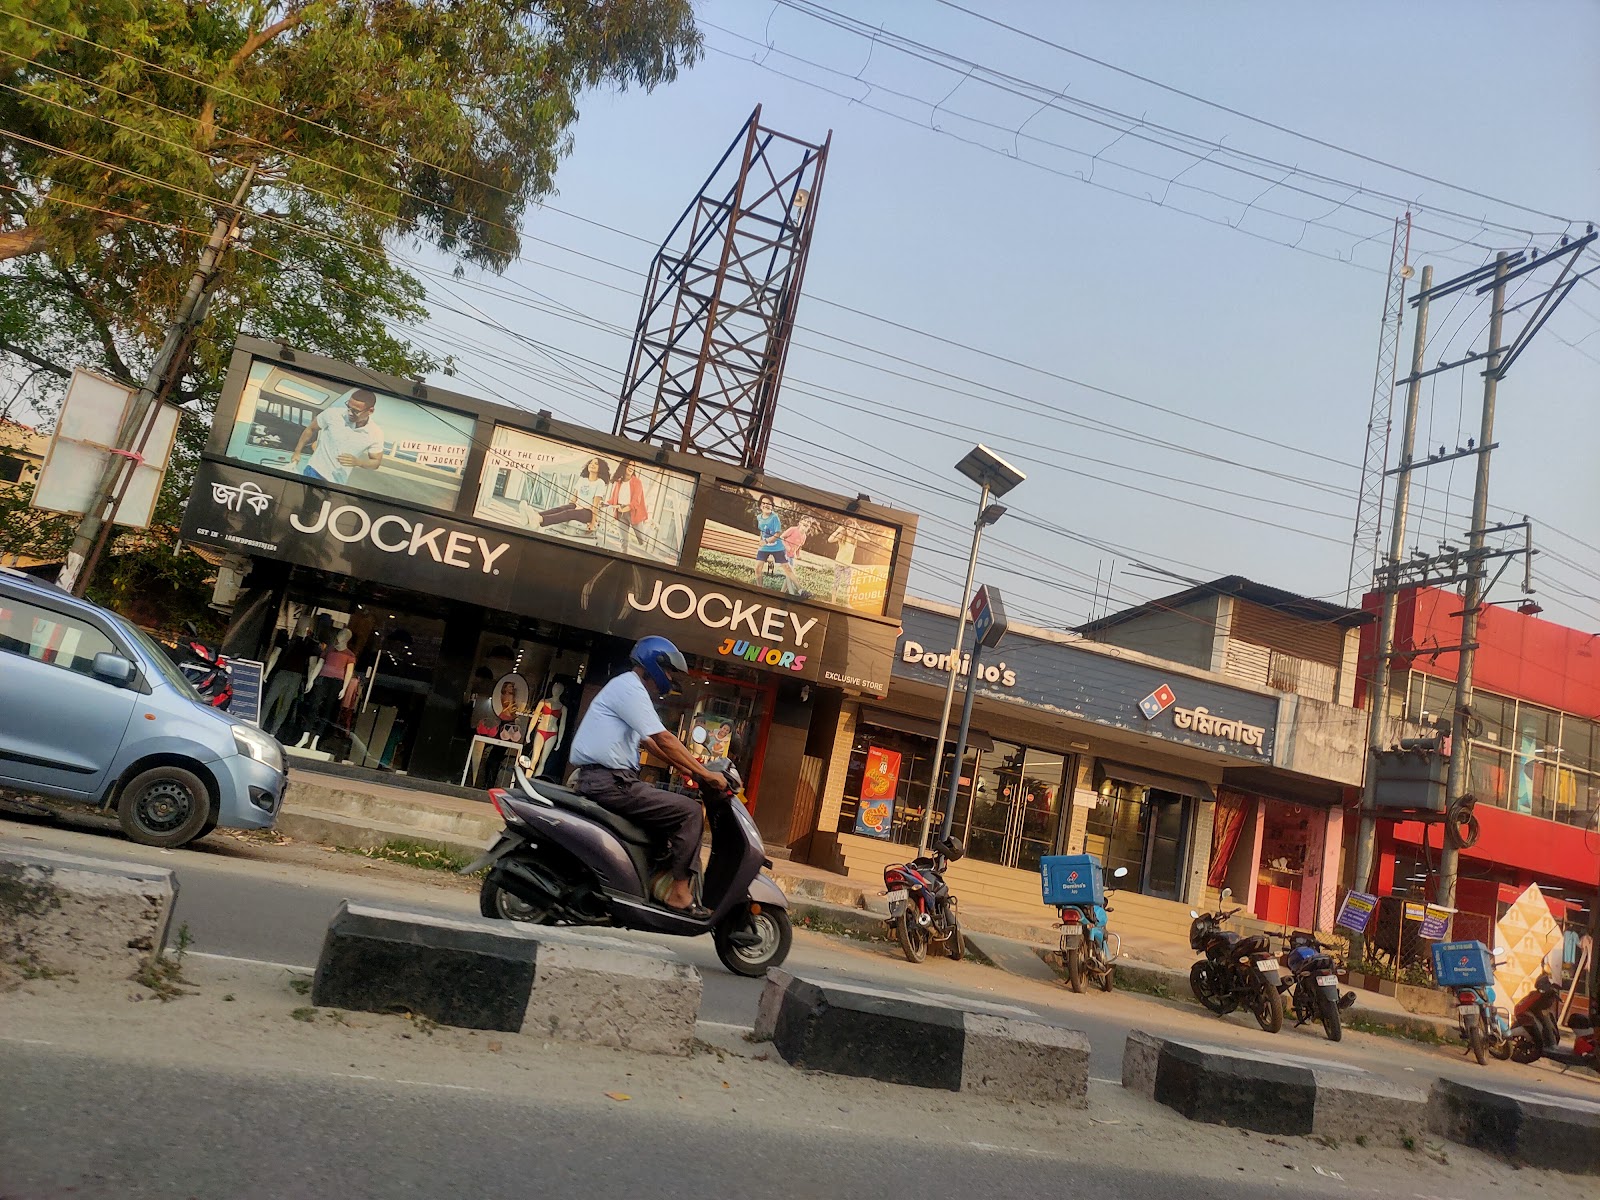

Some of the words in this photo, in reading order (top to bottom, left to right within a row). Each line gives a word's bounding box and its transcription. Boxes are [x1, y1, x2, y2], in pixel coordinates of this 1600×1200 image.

[402, 442, 421, 450] LIVE
[427, 444, 442, 453] THE
[447, 446, 466, 455] CITY
[494, 448, 512, 457] LIVE
[518, 451, 532, 459] THE
[537, 454, 555, 463] CITY
[419, 454, 429, 462] IN
[433, 456, 464, 466] JOCKEY
[491, 458, 501, 466] IN
[505, 460, 535, 470] JOCKEY
[289, 500, 510, 575] JOCKEY
[851, 566, 876, 577] BUSY
[627, 579, 819, 649] JOCKEY
[718, 638, 808, 671] JUNIORS
[825, 671, 861, 686] EXCLUSIVE
[862, 680, 884, 691] STORE
[1097, 797, 1109, 807] PEN
